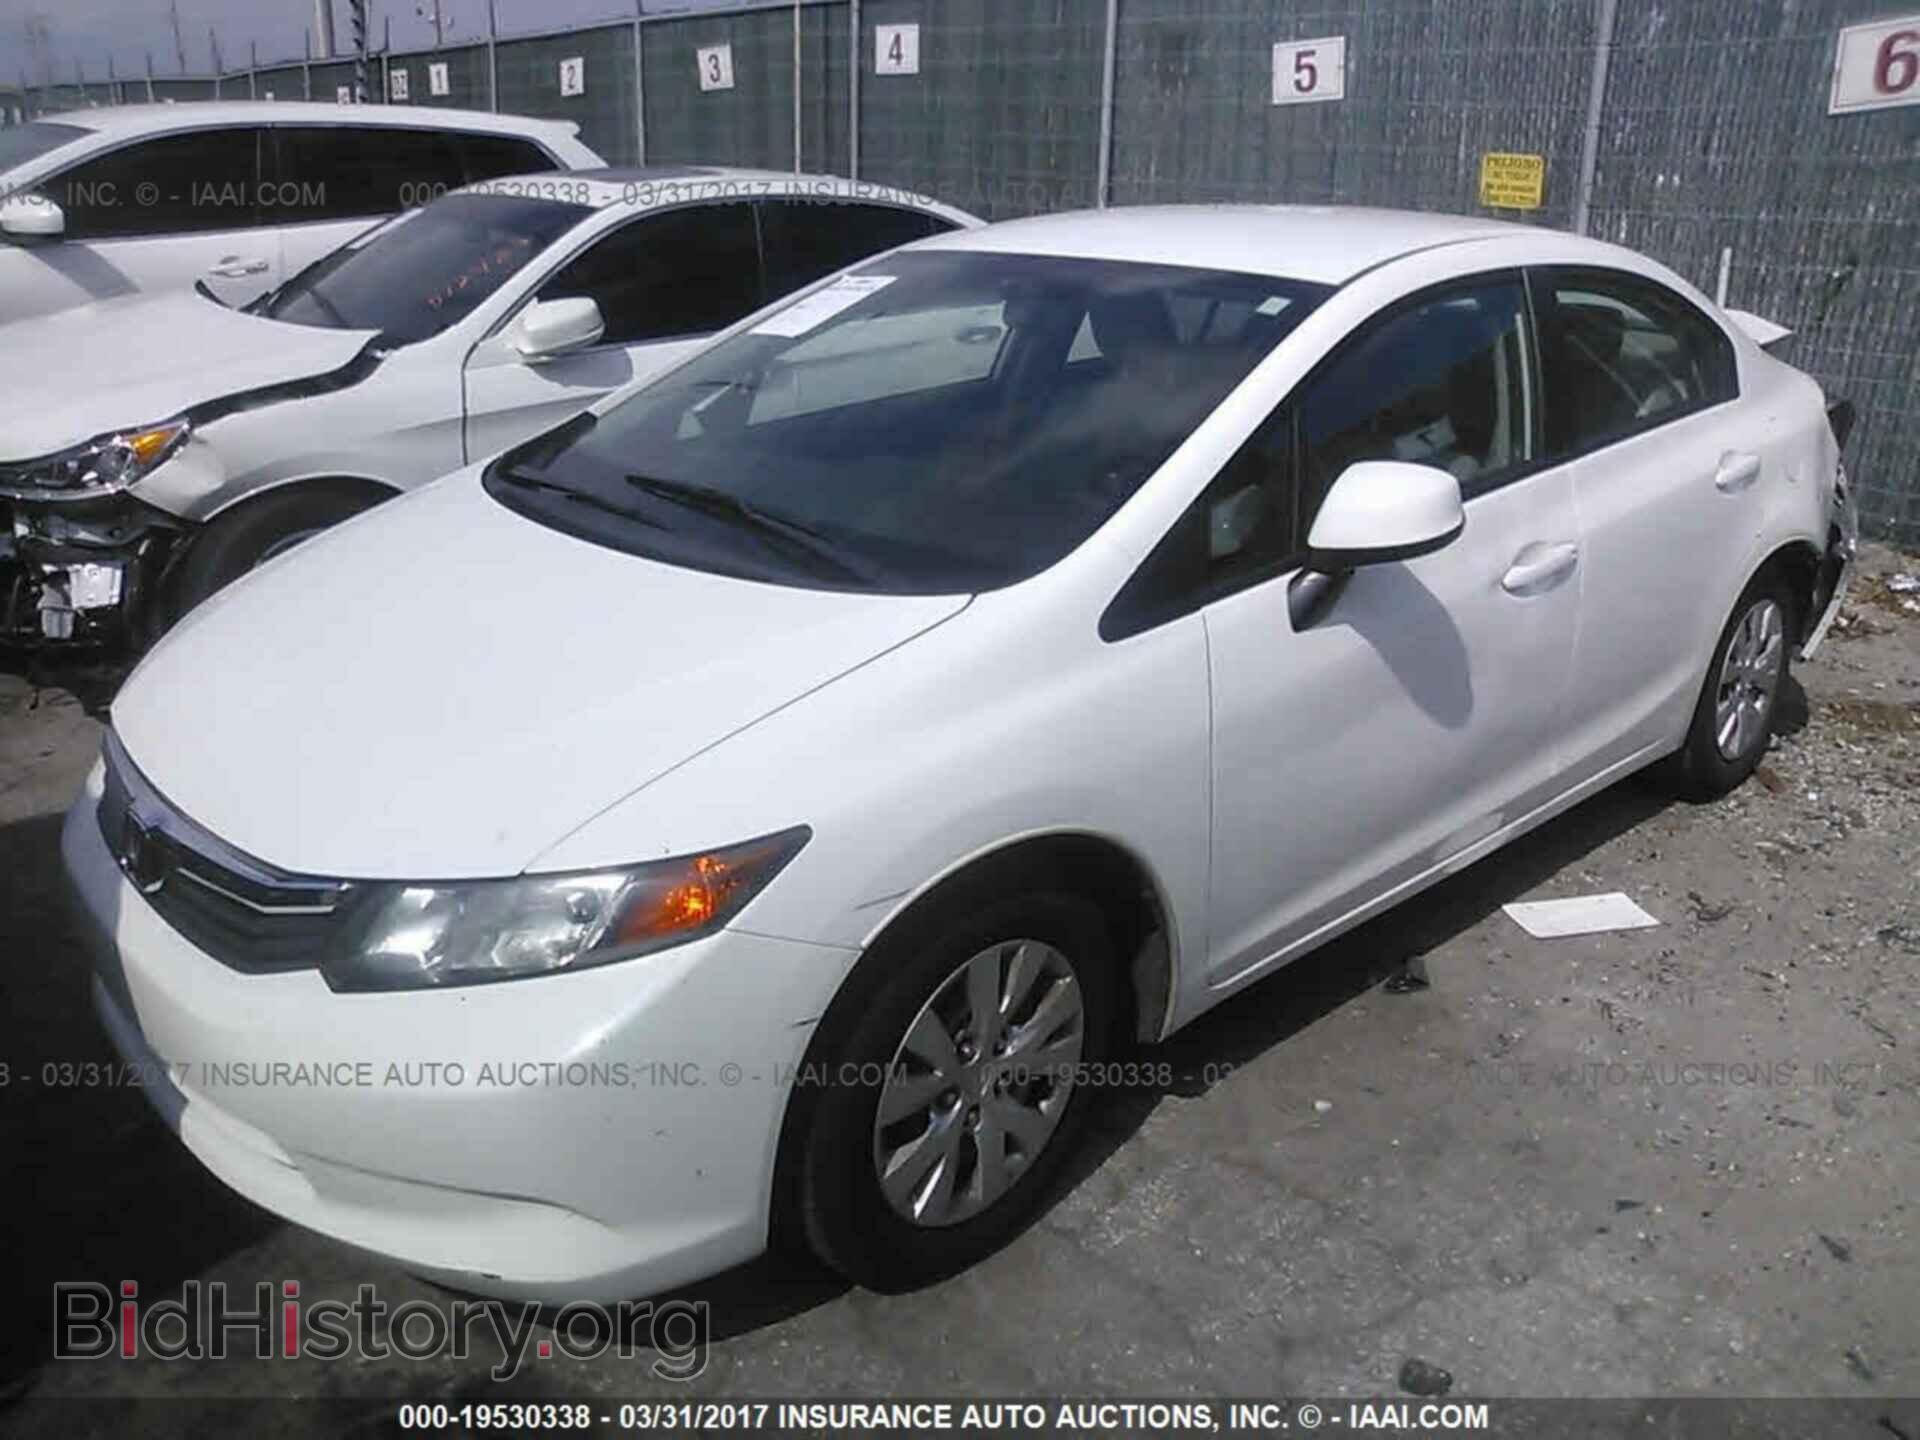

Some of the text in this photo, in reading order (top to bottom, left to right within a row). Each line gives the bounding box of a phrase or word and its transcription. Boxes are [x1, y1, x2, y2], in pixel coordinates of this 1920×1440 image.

[887, 32, 905, 66] 4
[1873, 30, 1920, 95] 6
[566, 63, 577, 90] 2
[708, 53, 721, 83] 3
[1294, 50, 1318, 93] 5
